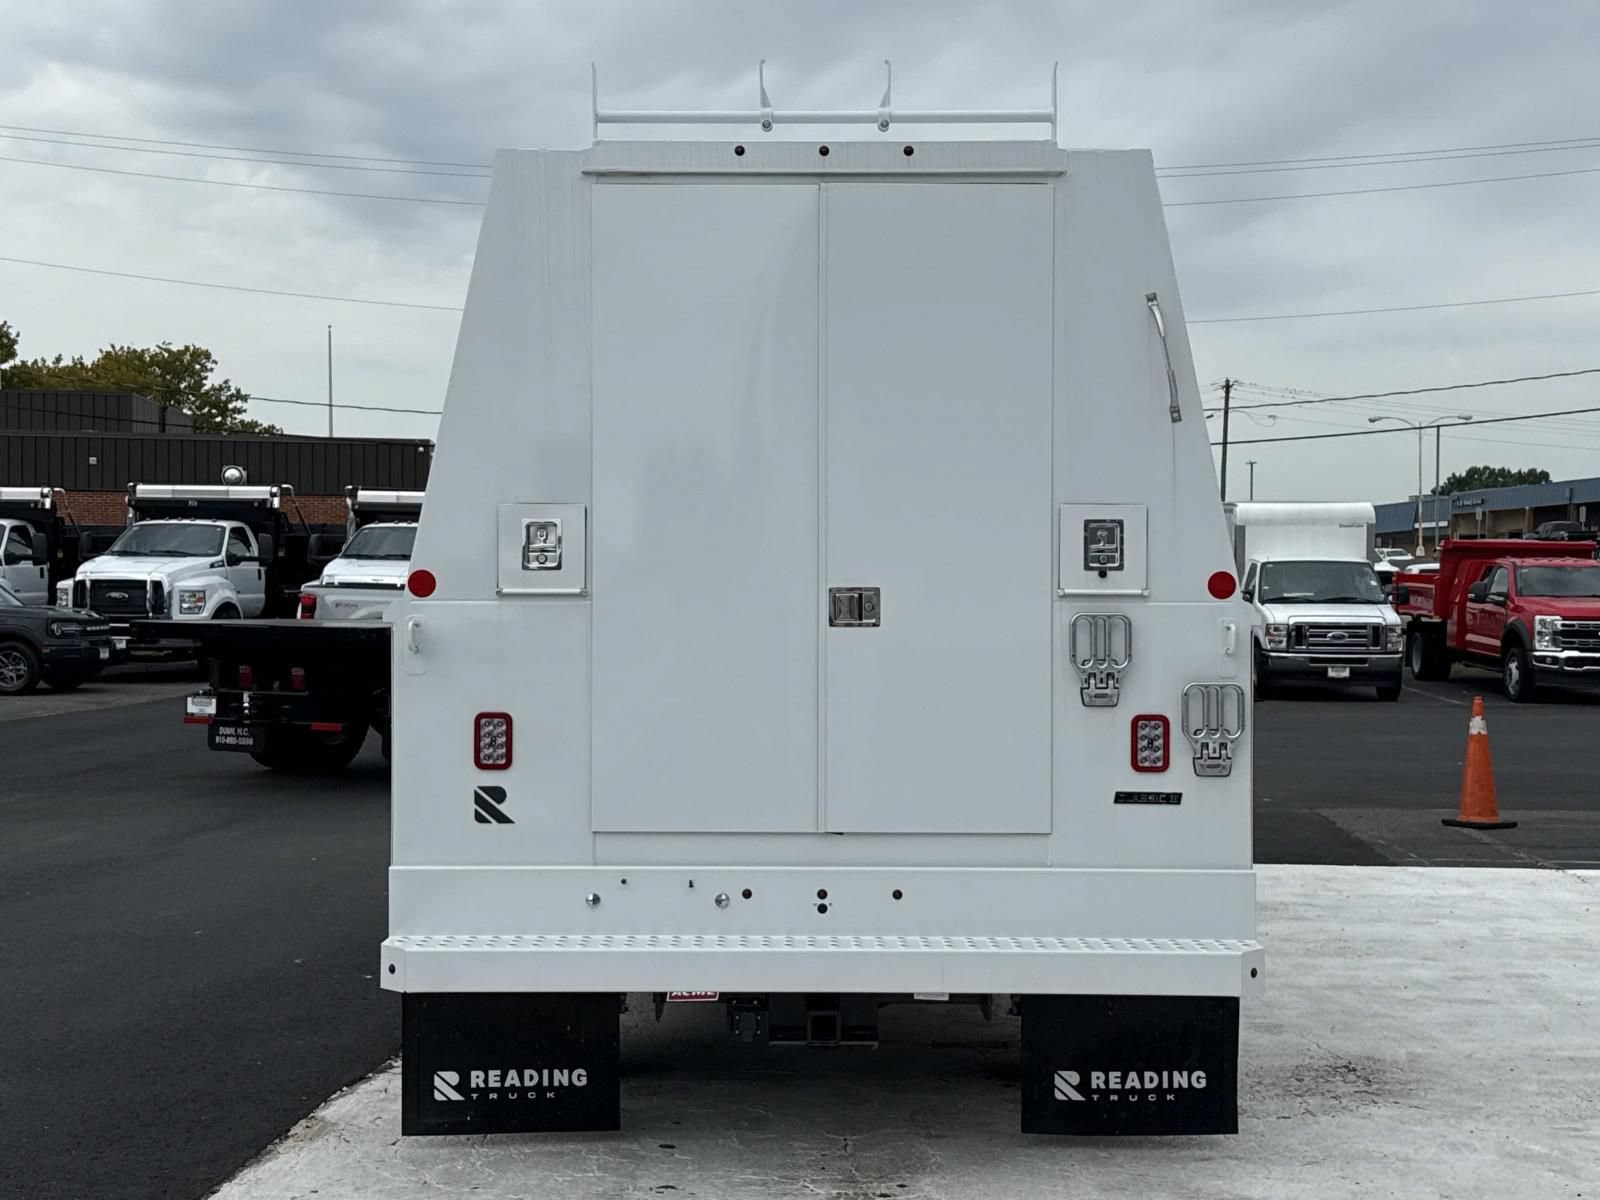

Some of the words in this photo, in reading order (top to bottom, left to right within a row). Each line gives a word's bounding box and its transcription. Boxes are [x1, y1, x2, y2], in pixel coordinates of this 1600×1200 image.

[470, 1068, 588, 1088] READING
[1091, 1070, 1207, 1089] READING
[471, 1091, 556, 1100] TRUCK
[1091, 1094, 1175, 1102] TRUCK
